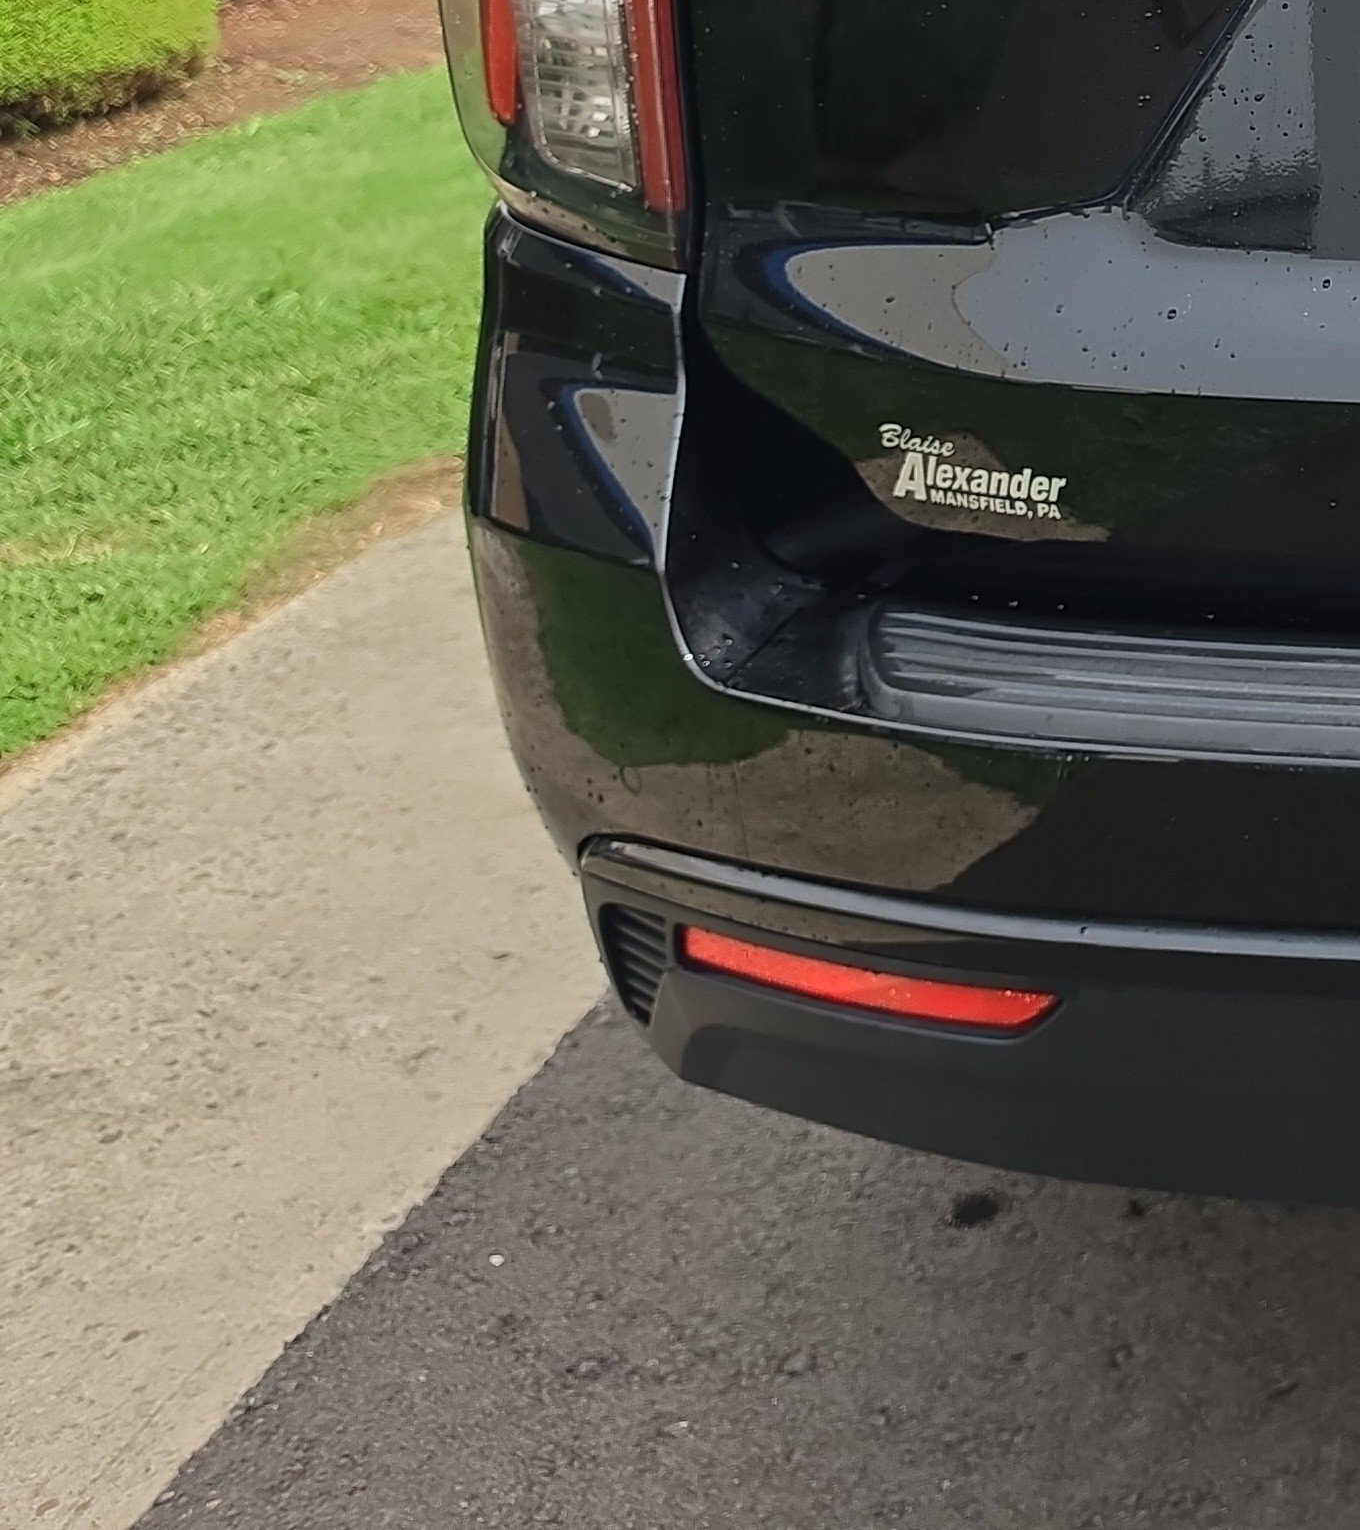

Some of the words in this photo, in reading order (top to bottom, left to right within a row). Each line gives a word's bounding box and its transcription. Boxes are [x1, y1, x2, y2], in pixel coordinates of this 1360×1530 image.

[878, 422, 956, 458] Blaise
[892, 451, 1067, 503] Alexander
[929, 488, 1034, 520] MANSFIELD,
[1037, 502, 1062, 521] PA
